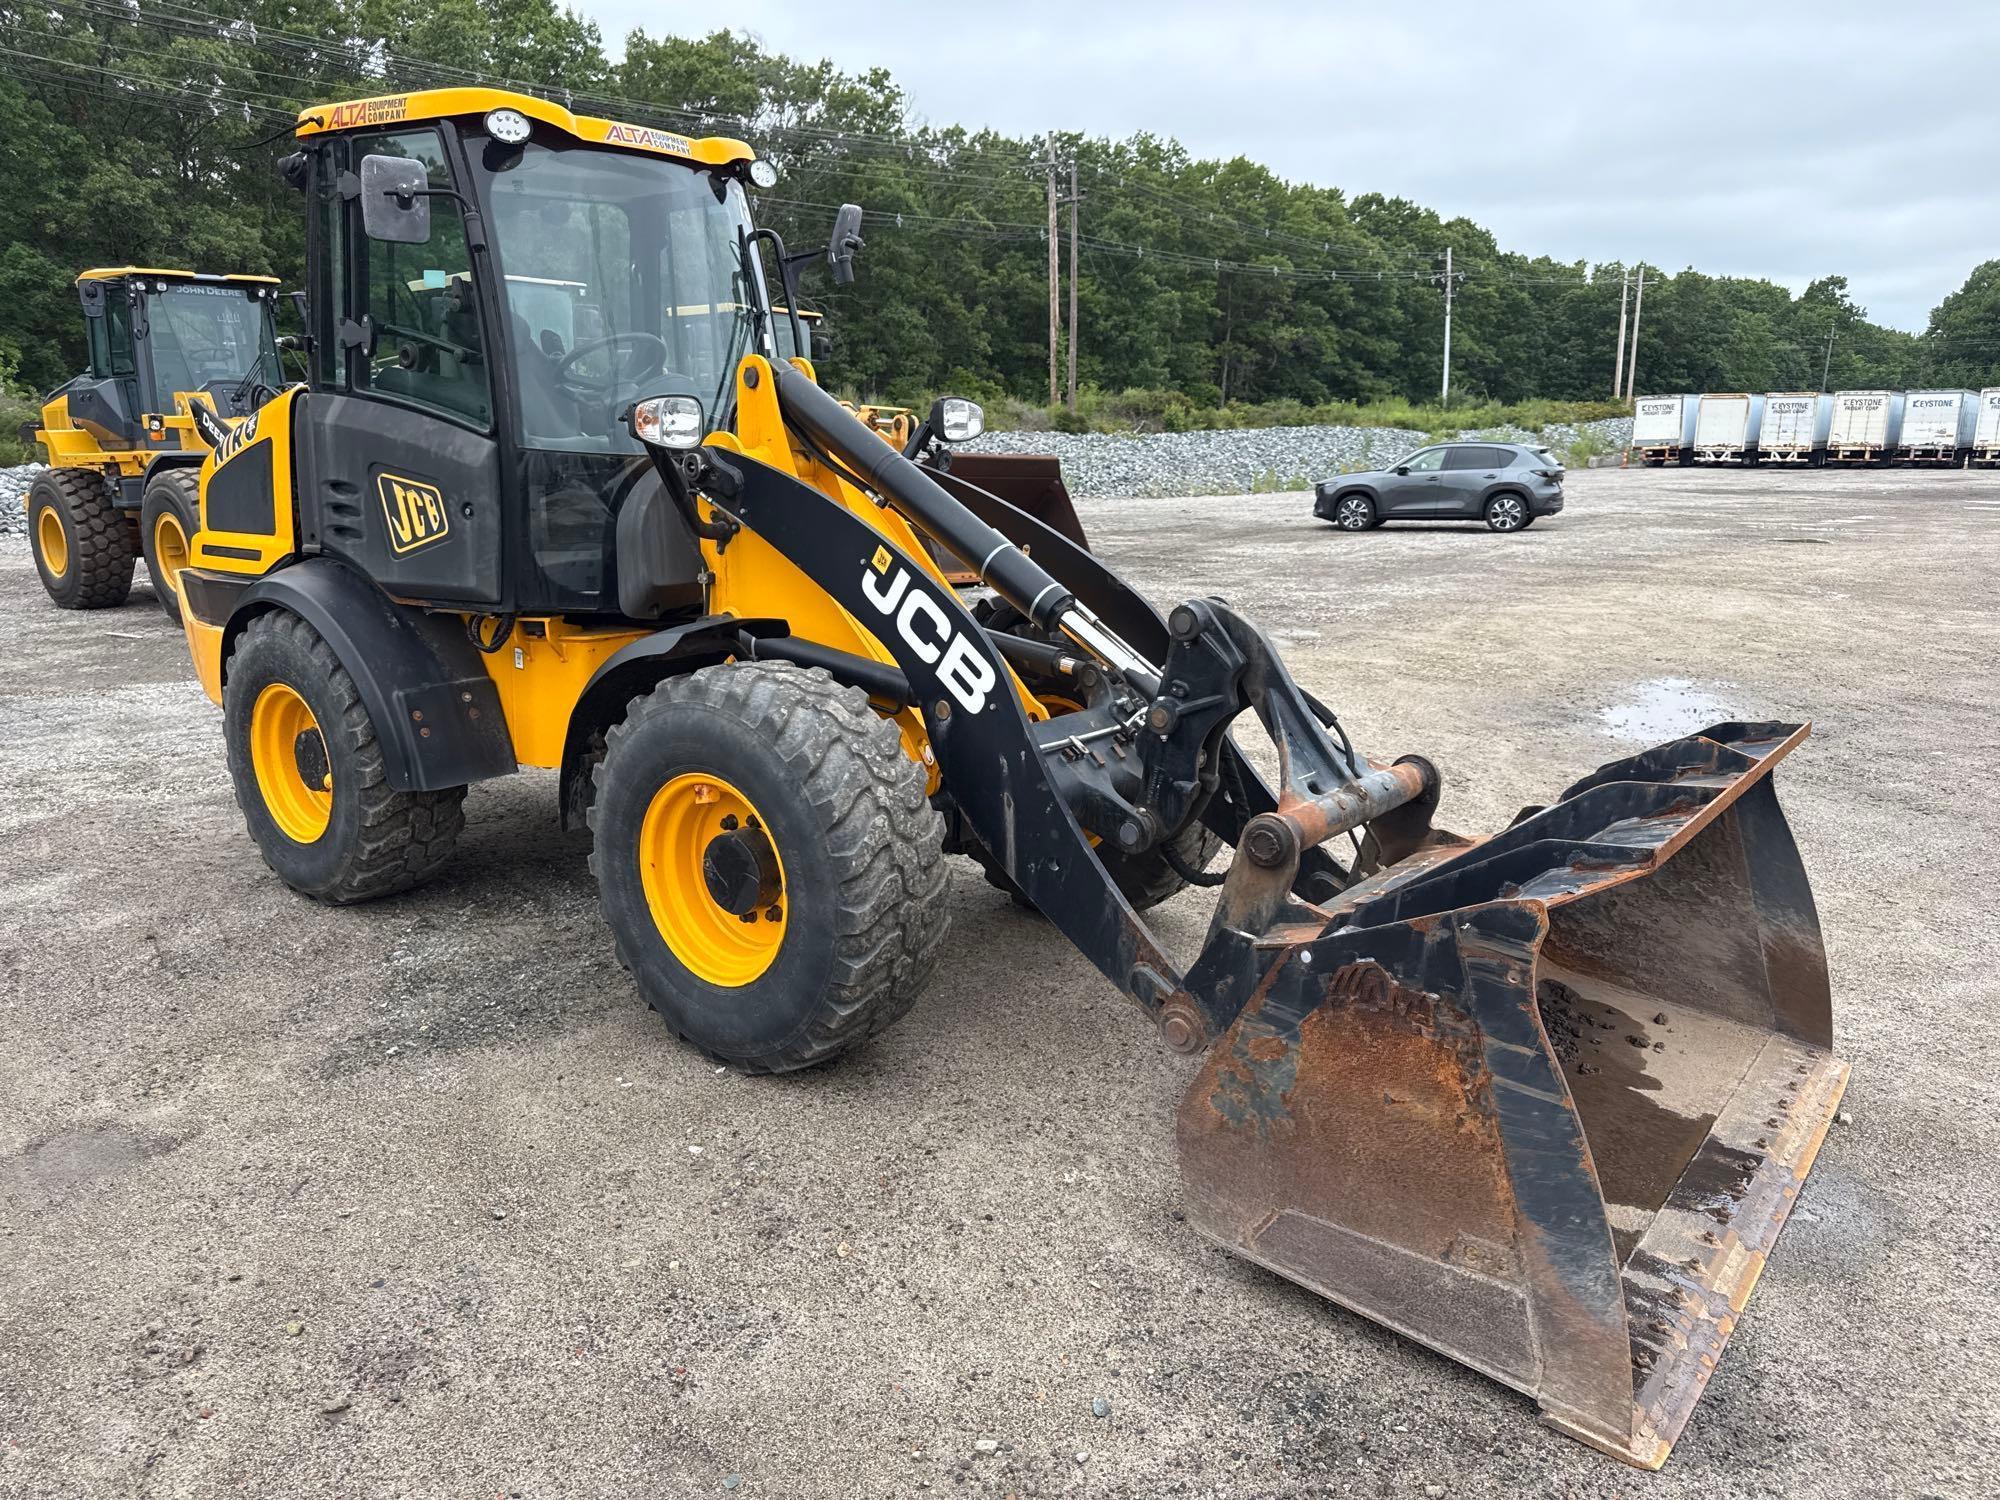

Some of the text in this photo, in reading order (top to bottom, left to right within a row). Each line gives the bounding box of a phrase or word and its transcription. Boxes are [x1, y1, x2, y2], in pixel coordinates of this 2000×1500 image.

[327, 97, 407, 129] ALTA EQUIPMENT
[367, 108, 407, 123] COMPANY
[606, 125, 688, 148] ALTA EQUIPMENT
[653, 140, 691, 156] COMPANY
[176, 285, 242, 297] JOHN DEERE
[1641, 403, 1676, 411] KEYSTONE
[1771, 402, 1809, 410] KEYSTONE
[1843, 398, 1883, 406] KEYSTONE
[1912, 399, 1954, 408] KEYSTONE
[202, 412, 226, 448] DEER
[391, 481, 440, 543] JCB
[861, 567, 996, 715] JCB
